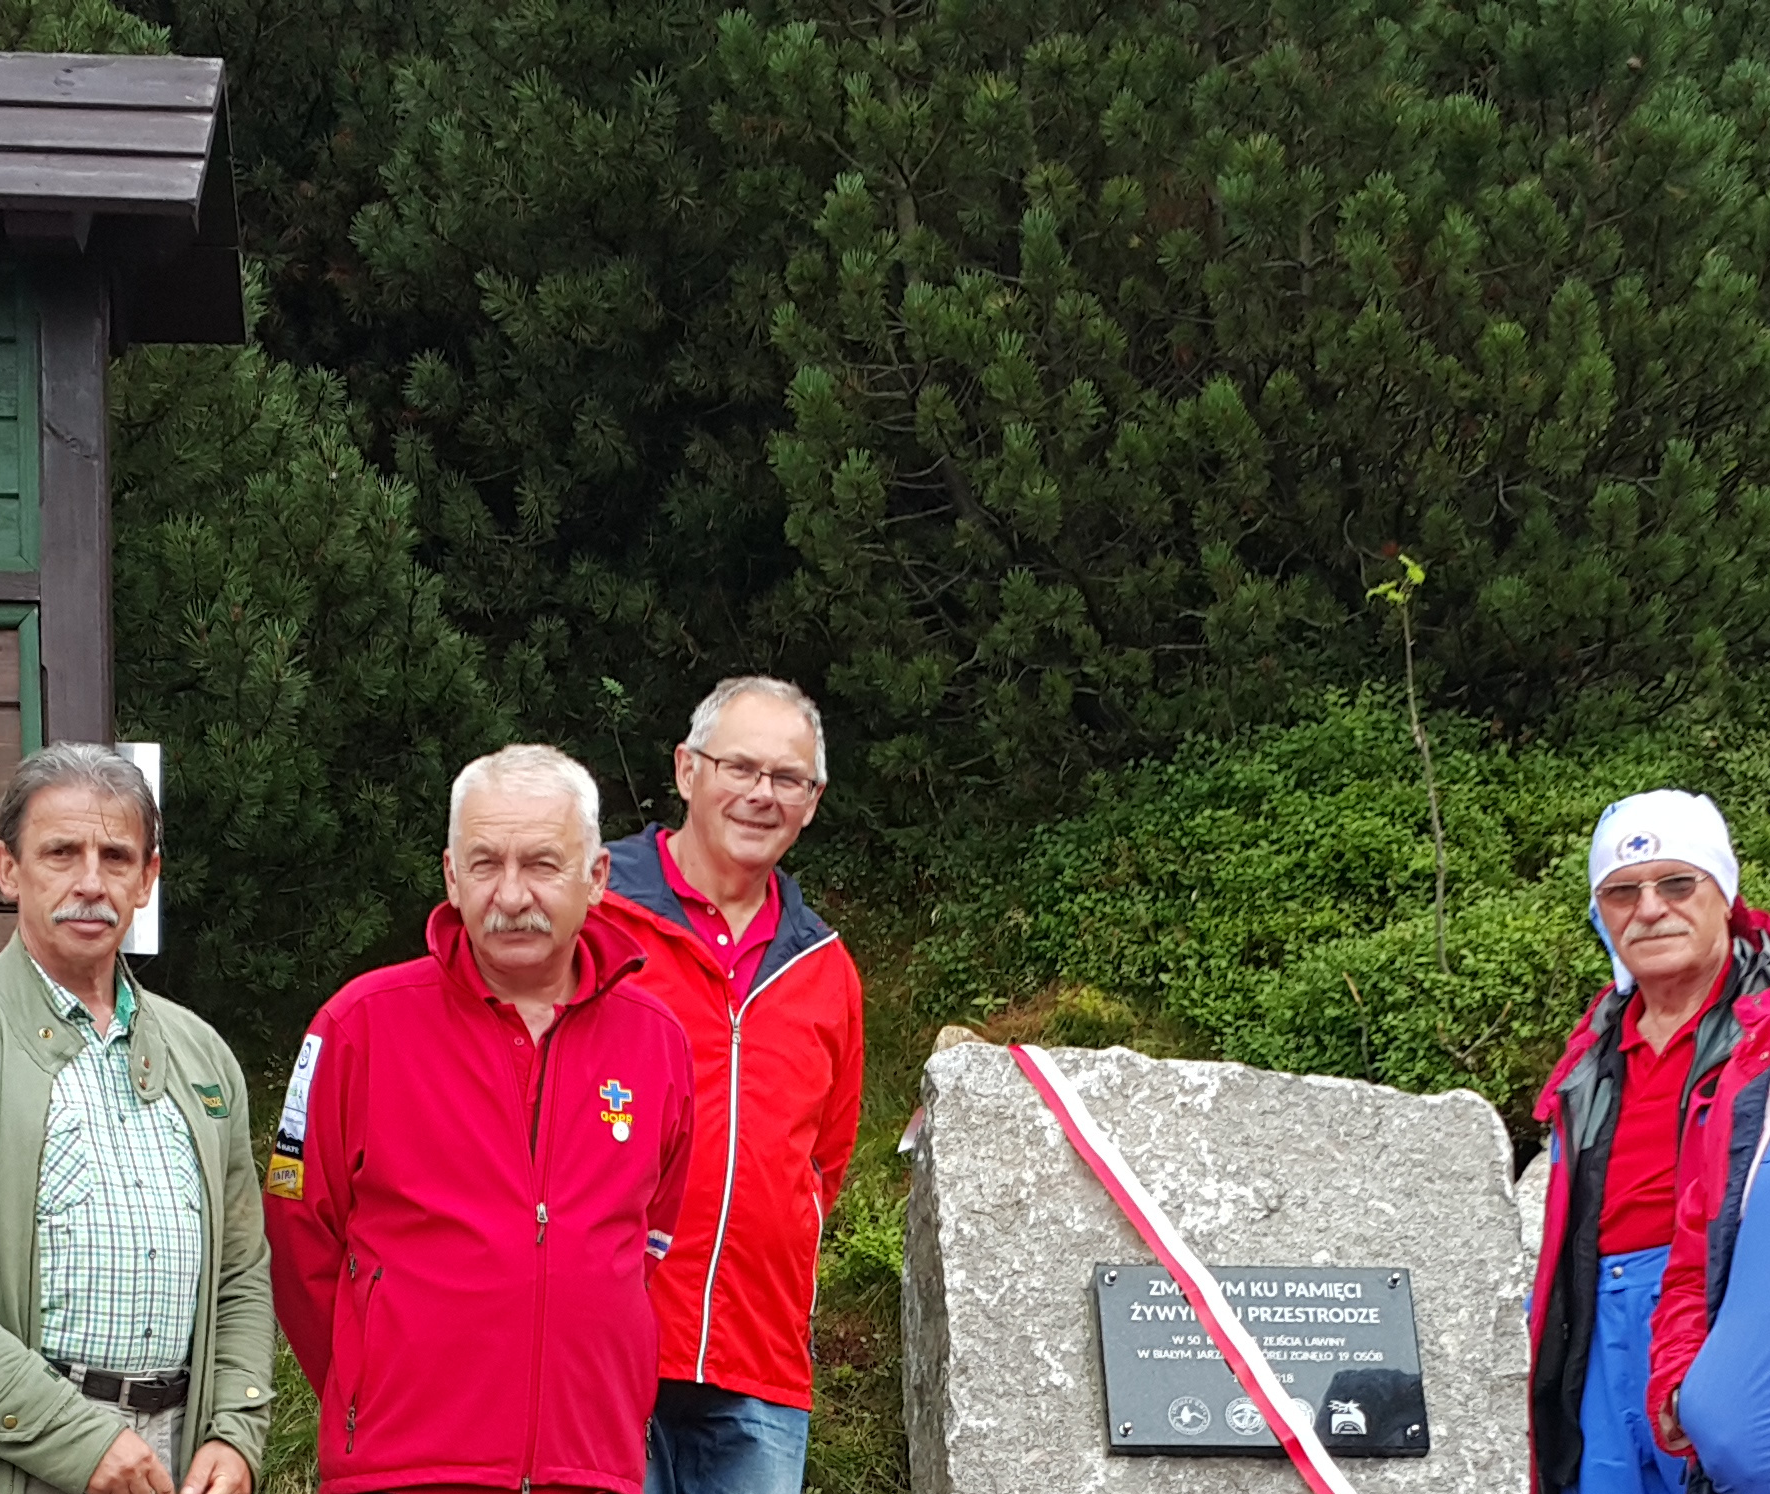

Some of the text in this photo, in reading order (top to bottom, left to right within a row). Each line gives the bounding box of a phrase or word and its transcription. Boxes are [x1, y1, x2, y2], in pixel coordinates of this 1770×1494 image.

[1251, 1281, 1278, 1298] KU
[1285, 1282, 1362, 1301] PAMIĘCI
[1130, 1302, 1196, 1322] ŻYWY
[1248, 1306, 1381, 1324] PRZESTRODZE
[1171, 1335, 1186, 1345] W
[1187, 1335, 1201, 1346] 50
[1305, 1336, 1346, 1347] LAWINY
[1137, 1349, 1151, 1359] W
